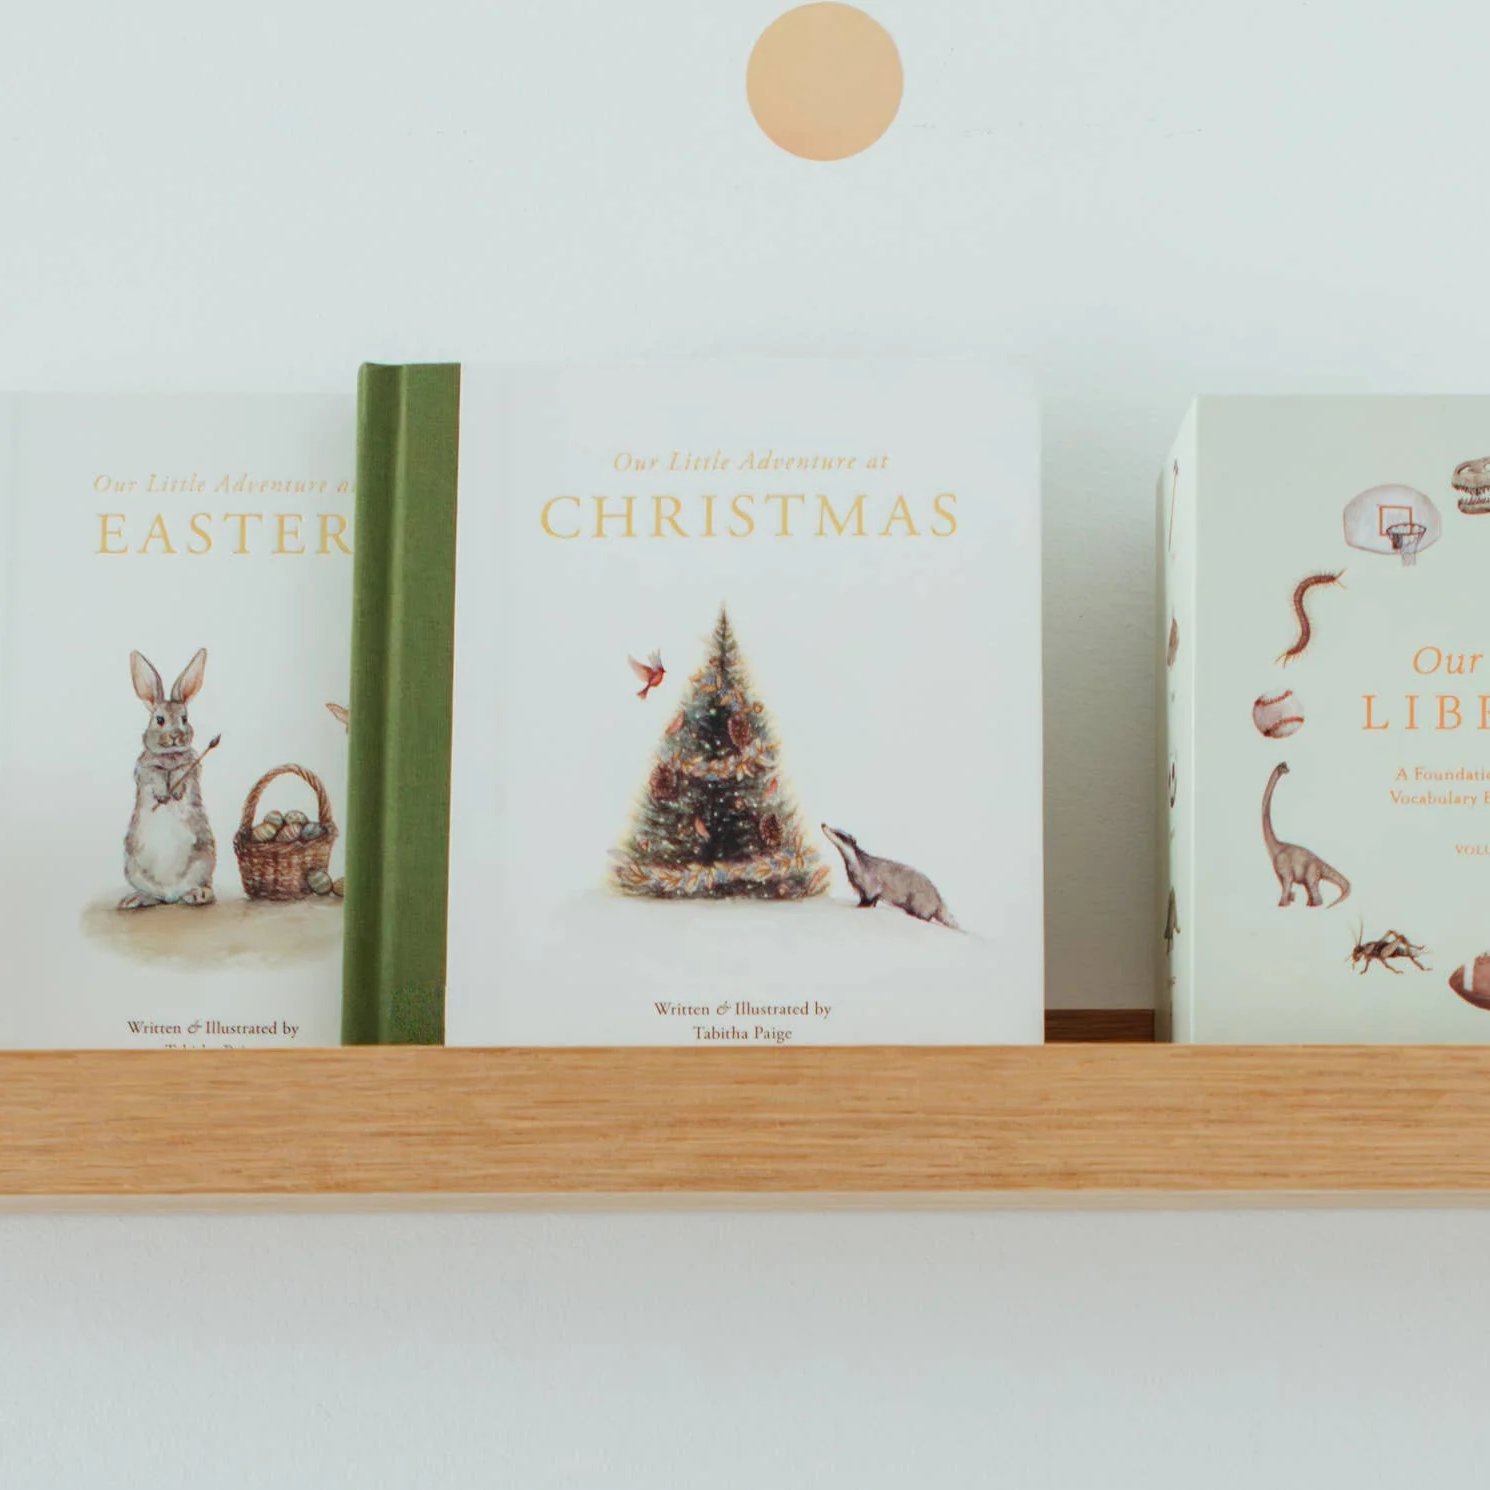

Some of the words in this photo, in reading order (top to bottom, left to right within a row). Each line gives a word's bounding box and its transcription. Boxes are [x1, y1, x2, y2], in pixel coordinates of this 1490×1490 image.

[613, 451, 659, 471] Our
[669, 449, 730, 471] Little
[738, 449, 856, 471] Adventure
[865, 453, 889, 470] at
[93, 474, 137, 492] Our
[146, 473, 206, 493] Little
[214, 473, 327, 493] Adventure
[540, 493, 959, 539] CHRISTMAS
[95, 512, 354, 555] EASTER
[1413, 645, 1484, 675] Our
[1395, 767, 1408, 781] A
[1389, 789, 1478, 808] Vocabulary
[654, 1001, 710, 1016] Written
[716, 1001, 731, 1016] &
[735, 1001, 809, 1016] Illustrated
[814, 1001, 832, 1019] by
[127, 1021, 182, 1034] Written
[187, 1020, 202, 1034] &
[205, 1021, 277, 1035] Illustrated
[282, 1021, 300, 1038] by
[693, 1026, 748, 1040] Tabitha
[754, 1026, 793, 1044] Paige
